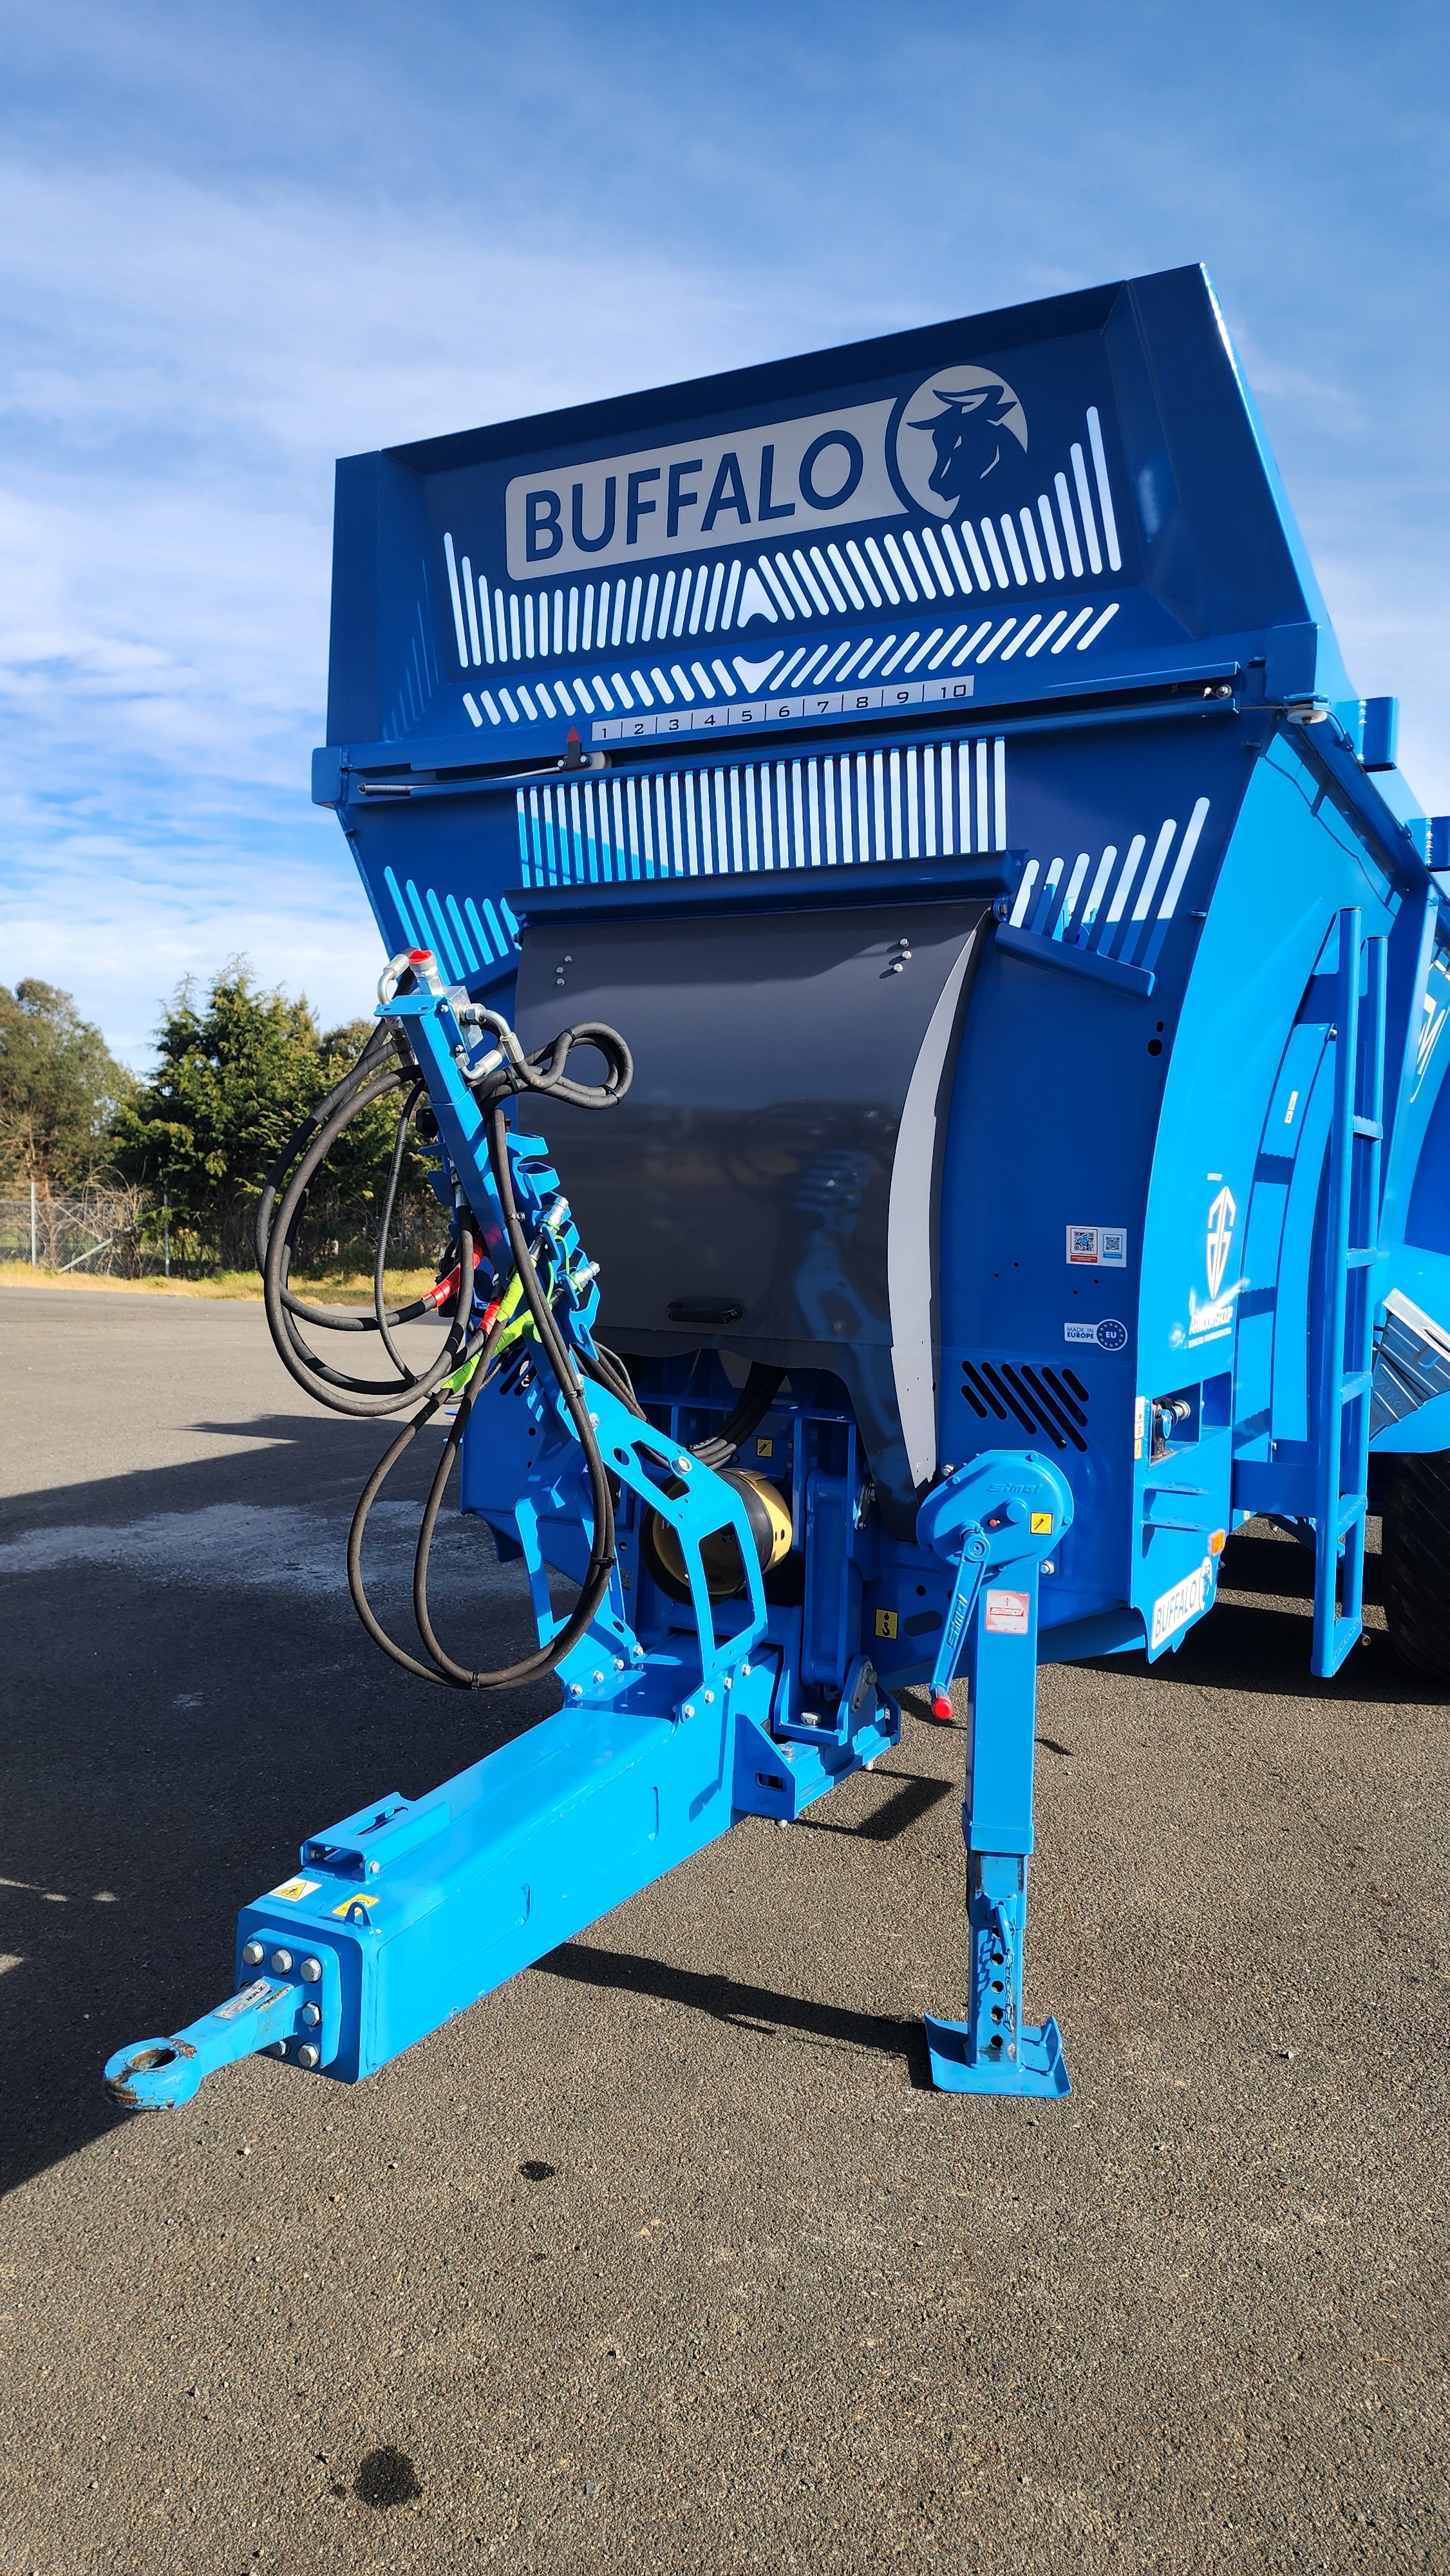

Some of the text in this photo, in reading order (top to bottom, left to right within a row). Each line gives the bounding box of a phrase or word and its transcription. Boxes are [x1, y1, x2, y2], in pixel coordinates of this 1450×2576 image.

[525, 430, 864, 563] BUFFALO
[634, 723, 644, 735] 2
[668, 719, 679, 731] 3
[704, 714, 716, 726] 4
[741, 710, 753, 723] 5
[778, 705, 790, 718] 6
[817, 701, 829, 714] 7
[856, 696, 869, 709] 8
[896, 691, 909, 704] 9
[940, 684, 966, 699] 10
[1156, 1579, 1197, 1639] BUFFALO
